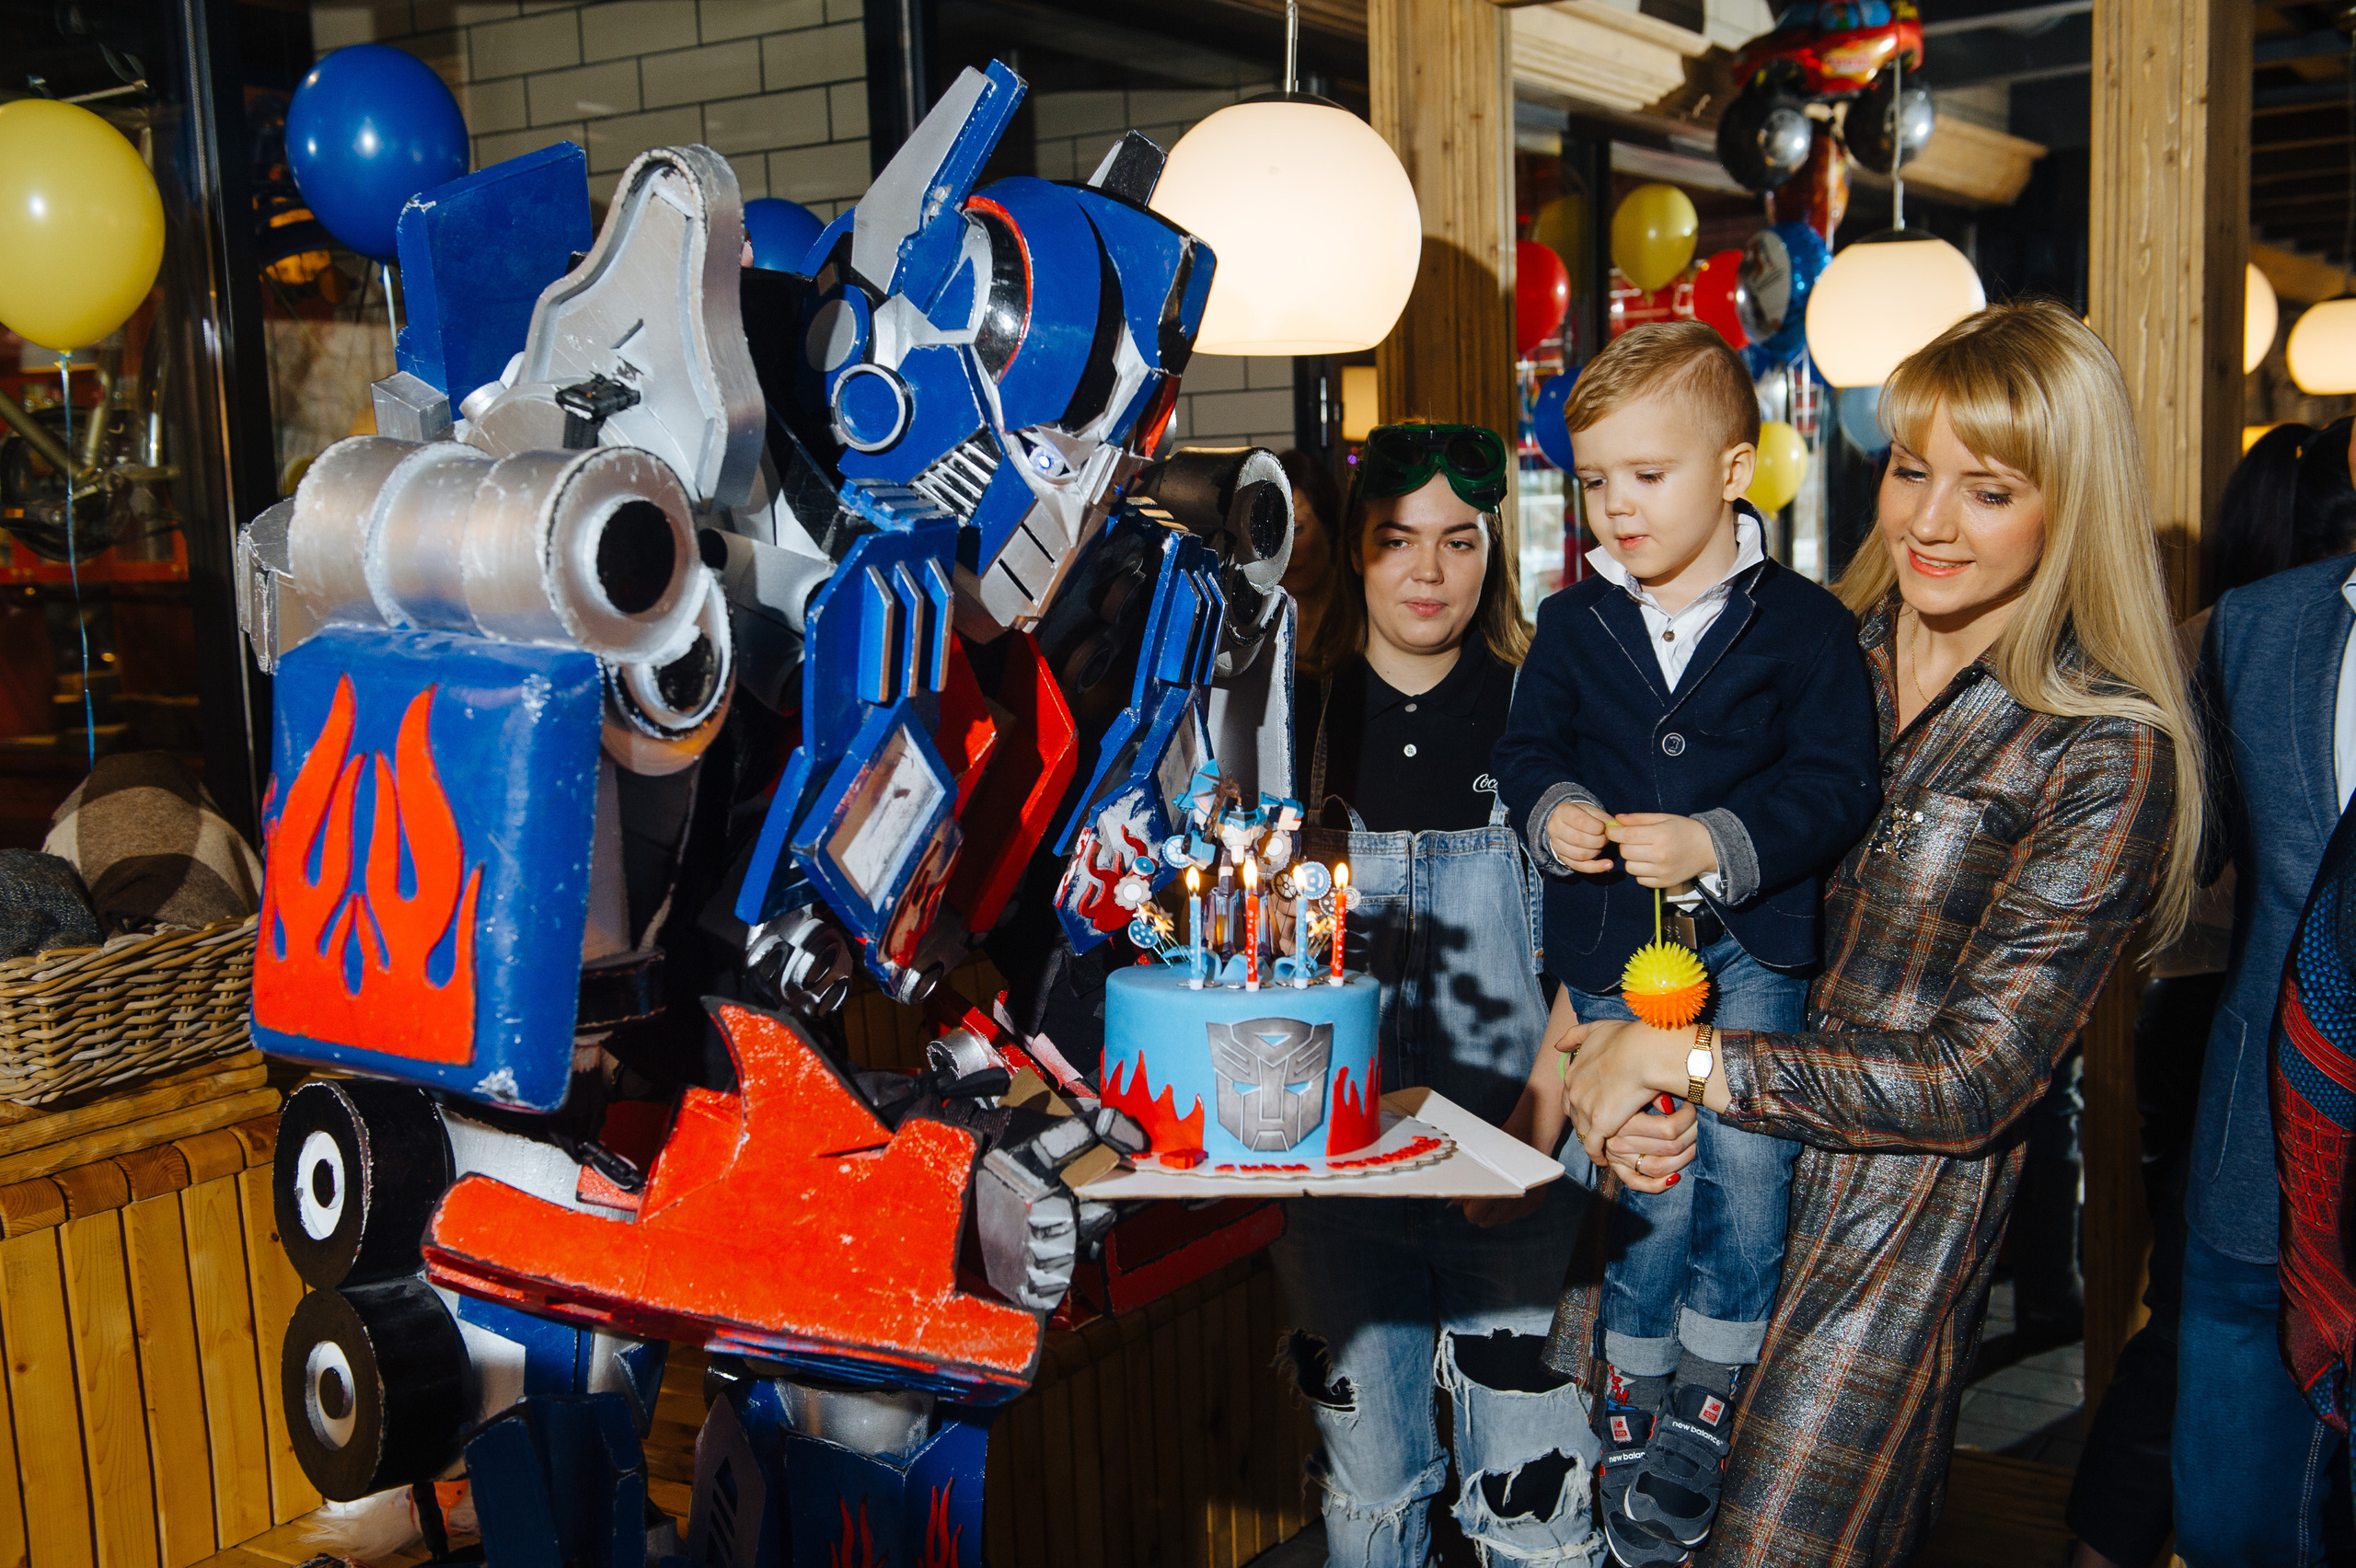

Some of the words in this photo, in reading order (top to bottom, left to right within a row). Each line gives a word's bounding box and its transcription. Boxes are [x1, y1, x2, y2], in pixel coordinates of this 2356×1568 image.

[1672, 1421, 1691, 1431] new
[1690, 1425, 1722, 1447] balance
[1609, 1454, 1623, 1463] new
